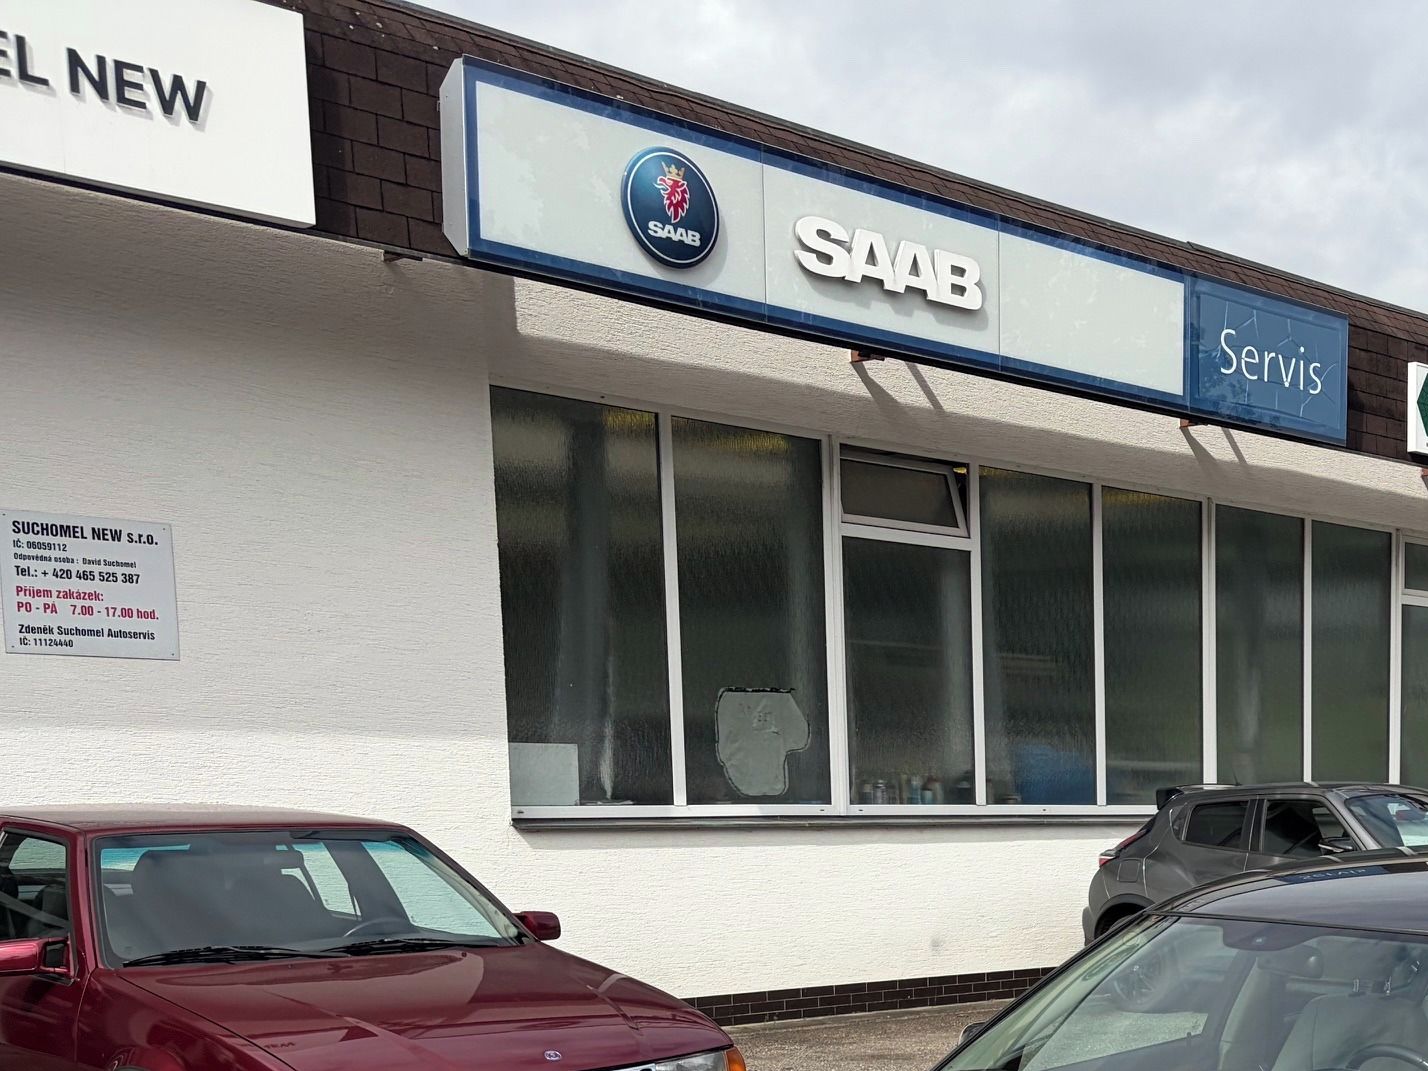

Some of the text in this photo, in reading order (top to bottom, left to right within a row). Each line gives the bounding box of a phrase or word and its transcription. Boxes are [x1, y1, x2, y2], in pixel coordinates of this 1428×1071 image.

[66, 47, 206, 121] NEW
[648, 220, 701, 247] SAAB
[793, 216, 983, 311] SAAB
[1220, 328, 1322, 395] Servis
[12, 520, 158, 546] SUCHOMEL NEW s.r.o.
[13, 538, 67, 552] IČ: 06059112
[82, 557, 101, 566] David
[103, 558, 137, 568] Suchomel
[14, 565, 140, 584] Tel.: + 420 465 525 387
[16, 585, 104, 602] Příjem zakázek:
[17, 601, 32, 613] PO
[70, 604, 94, 616] 7.00
[105, 606, 133, 618] 17.00
[136, 608, 159, 620] hod.
[18, 624, 156, 641] Zdeněk Suchomel Autoservis
[19, 635, 74, 648] IČ: 11124440
